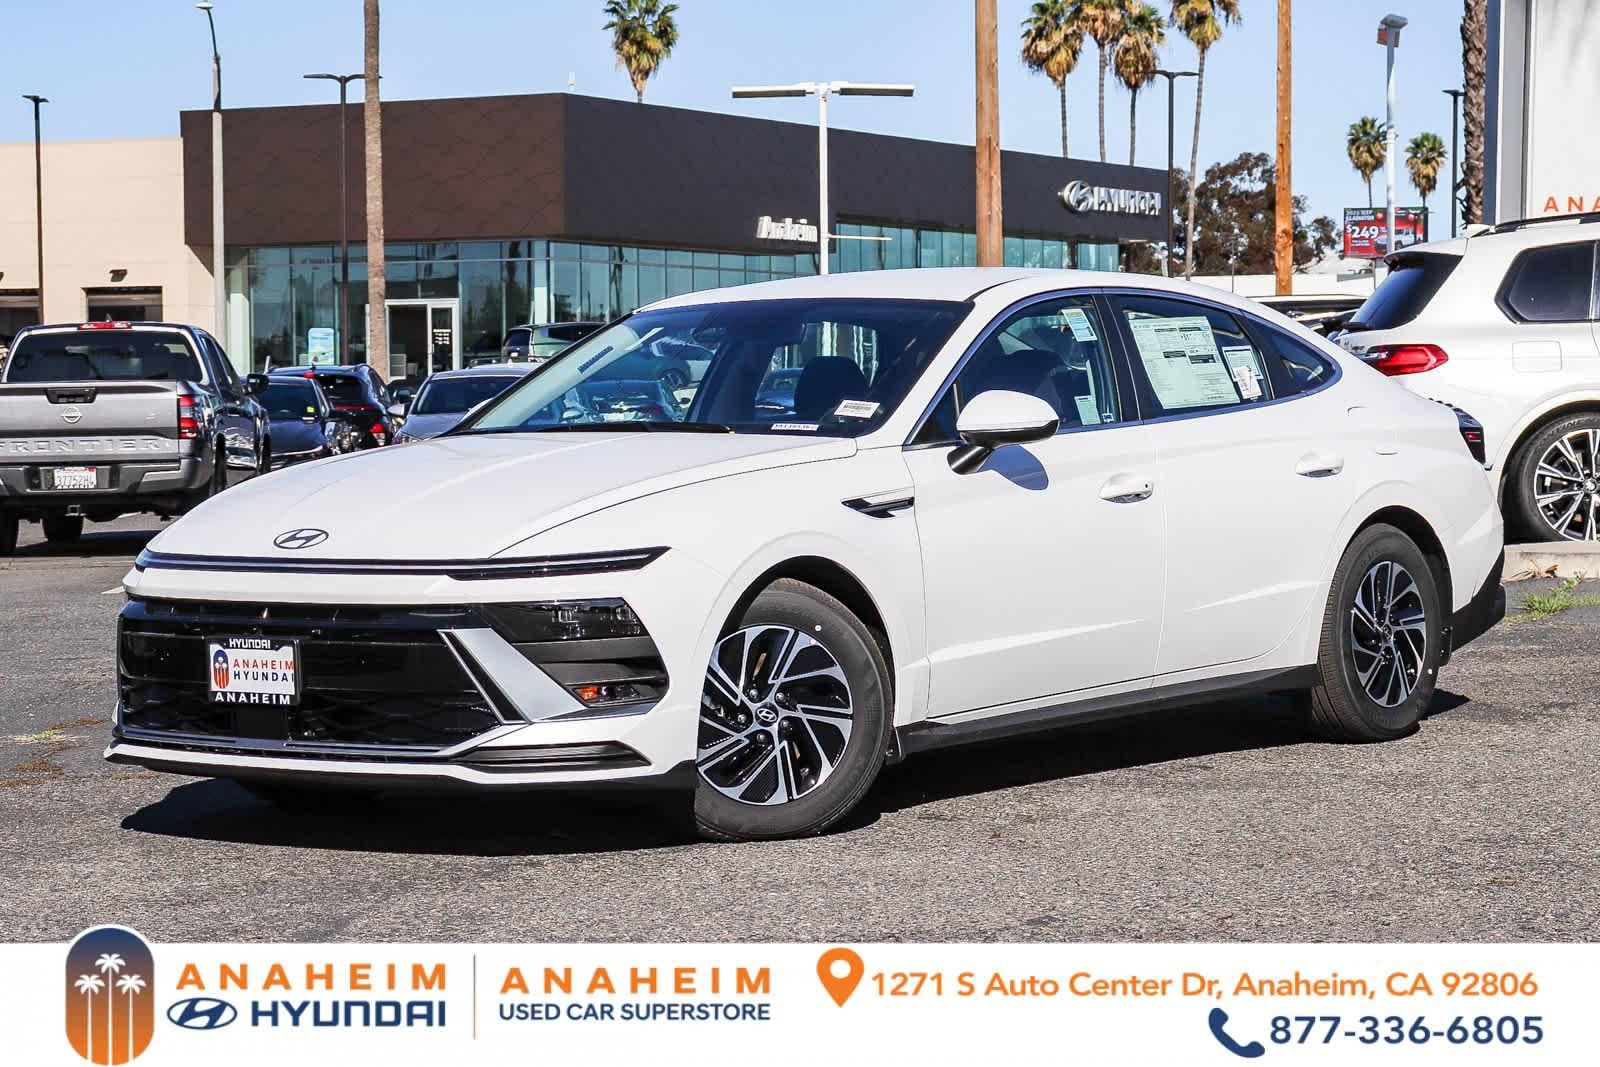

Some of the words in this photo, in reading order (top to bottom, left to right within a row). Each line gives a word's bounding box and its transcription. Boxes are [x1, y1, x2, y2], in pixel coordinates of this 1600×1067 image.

[756, 215, 818, 243] Anaheim
[1346, 223, 1379, 239] $249
[229, 638, 271, 649] HYUNDAI
[233, 659, 294, 671] ANAHEIM
[233, 670, 294, 682] HYUNDAI
[215, 692, 291, 705] ANAHEIM
